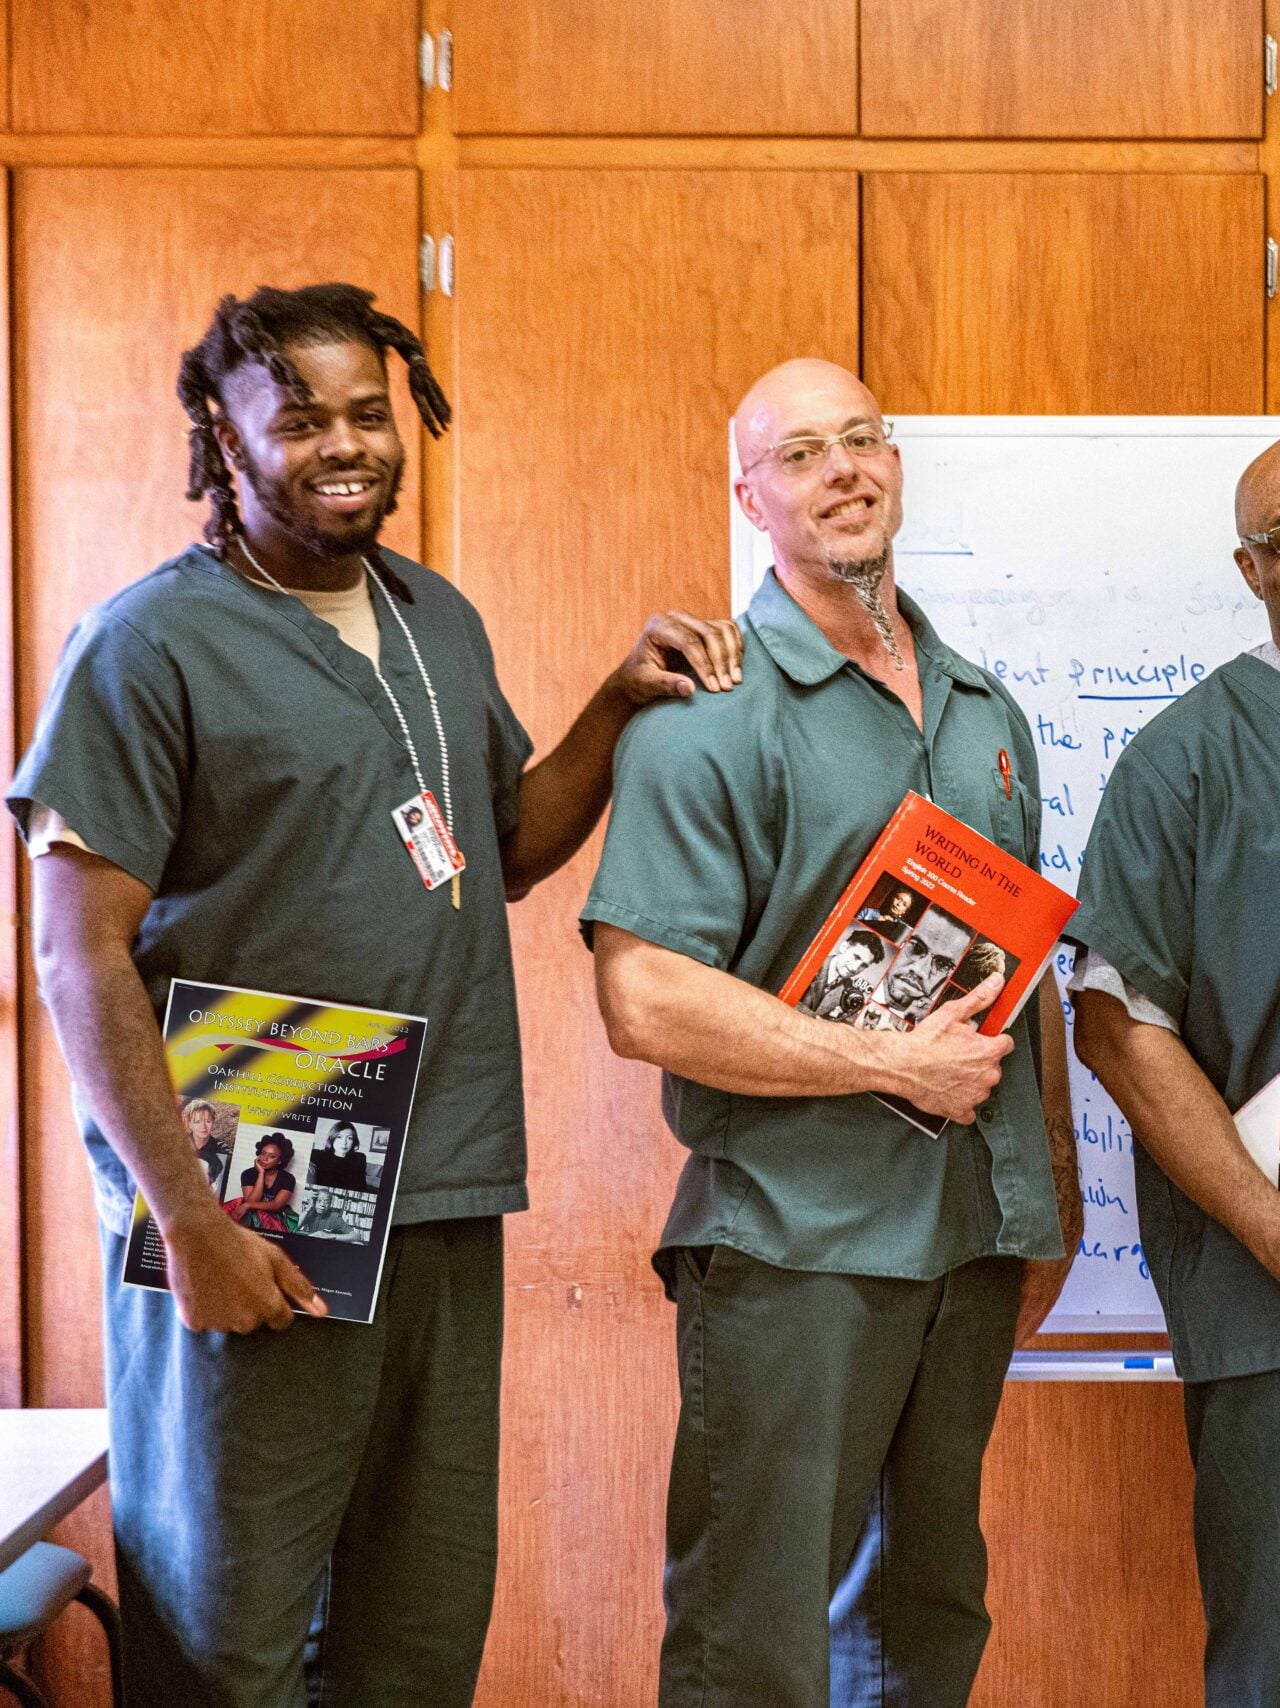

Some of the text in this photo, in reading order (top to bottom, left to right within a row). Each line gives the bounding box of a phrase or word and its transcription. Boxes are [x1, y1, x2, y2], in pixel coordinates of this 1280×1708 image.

[1037, 713, 1082, 750] the
[914, 840, 963, 879] WORLD
[925, 824, 1023, 898] WRITING IN THE
[855, 978, 874, 994] BBC
[189, 1009, 389, 1052] ODYSSEY BEYOND BARS
[207, 1064, 364, 1098] OAKHILL CORRECTIONAL
[295, 1052, 387, 1081] ORACLE
[214, 1080, 353, 1111] INSTITUTION EDITION
[281, 1111, 312, 1123] WRITE
